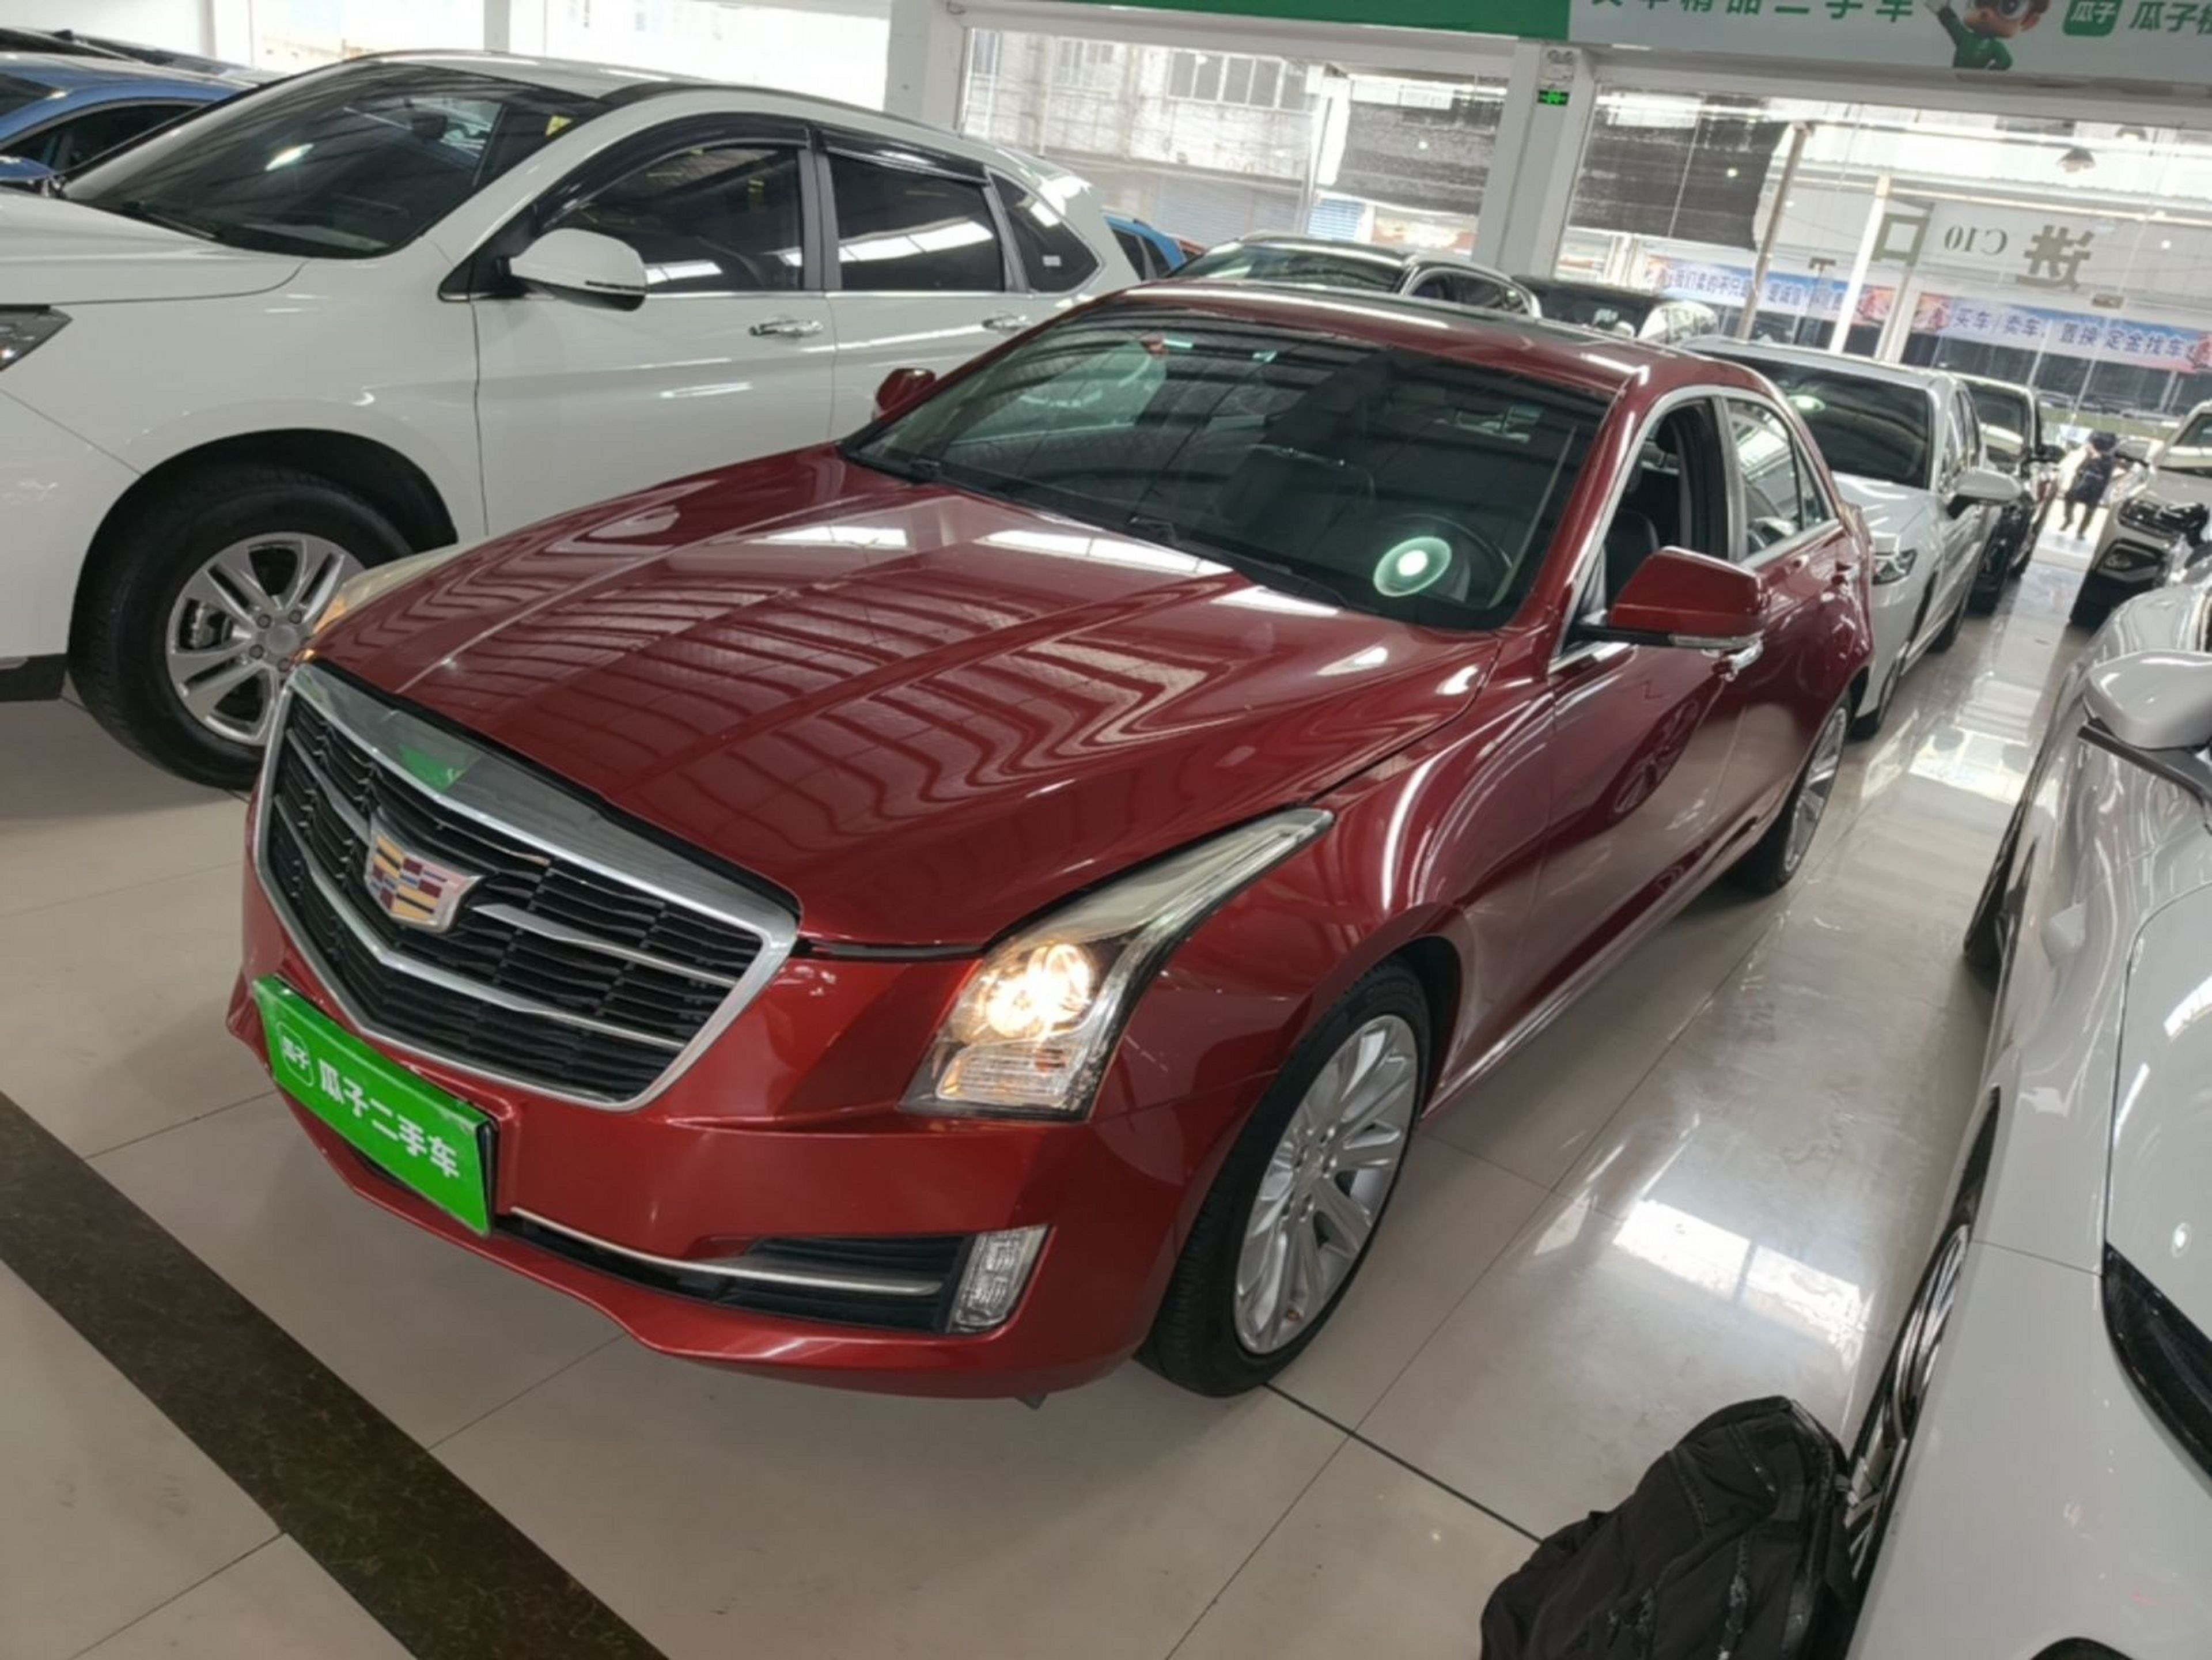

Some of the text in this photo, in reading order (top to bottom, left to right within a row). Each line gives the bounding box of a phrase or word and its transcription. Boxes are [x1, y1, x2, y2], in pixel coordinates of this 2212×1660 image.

[2070, 2, 2116, 23] 瓜子
[318, 1058, 460, 1179] 瓜子二手车
